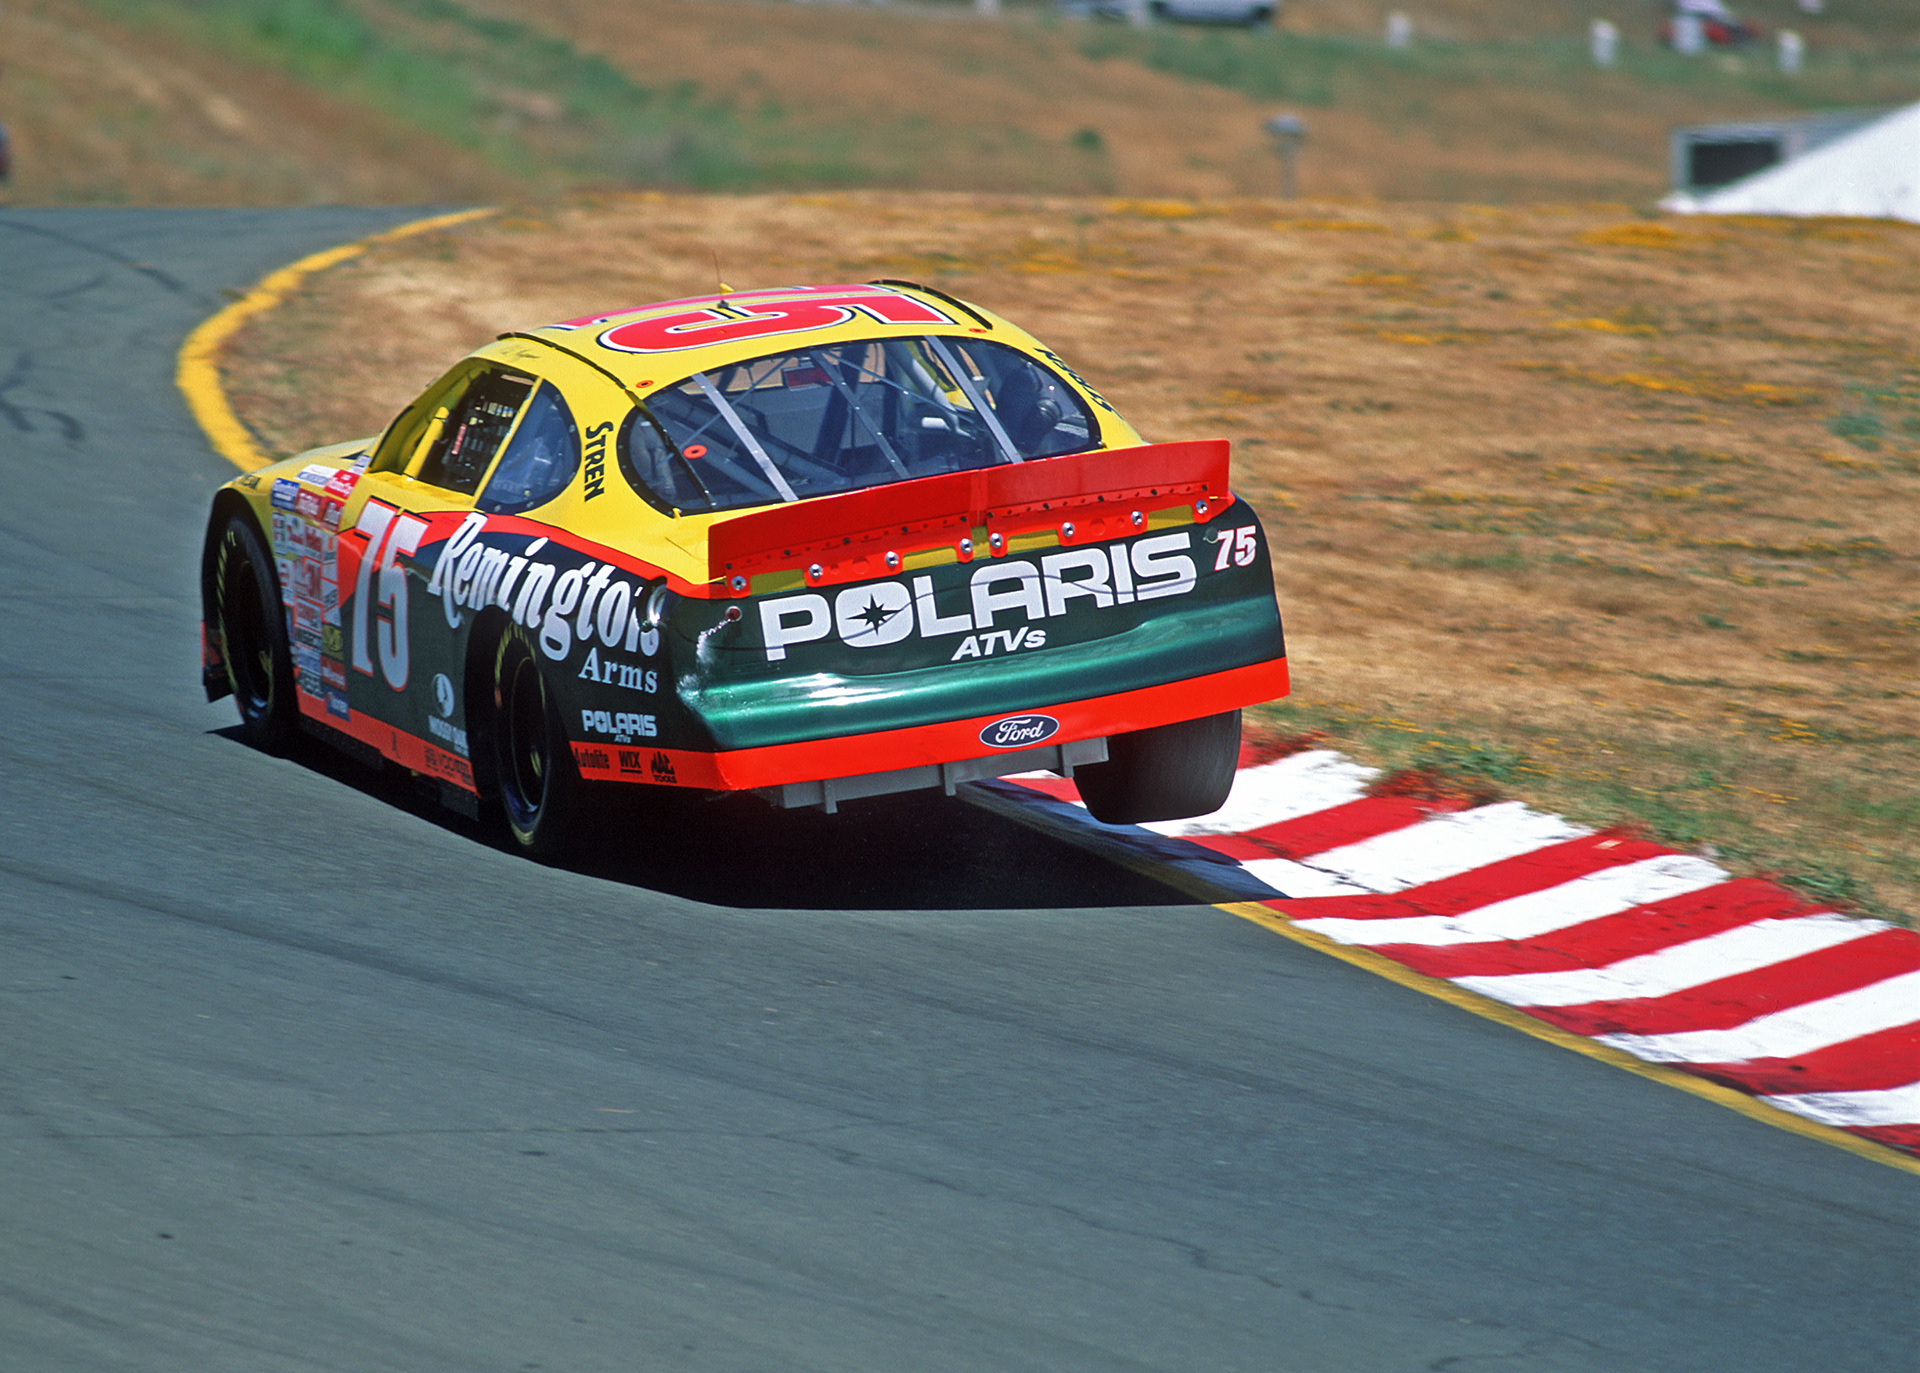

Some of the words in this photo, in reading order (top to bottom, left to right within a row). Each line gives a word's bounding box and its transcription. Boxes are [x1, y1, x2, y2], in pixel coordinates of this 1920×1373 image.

[584, 421, 614, 502] STREN
[1214, 525, 1257, 571] 75
[353, 496, 432, 691] 75
[758, 532, 1198, 661] POLARIS
[951, 626, 1046, 661] ATVs
[578, 647, 658, 694] Arms
[581, 709, 658, 737] POLARIS
[994, 719, 1044, 743] Ford
[618, 750, 642, 769] WIX
[653, 774, 677, 784] TOOLS
